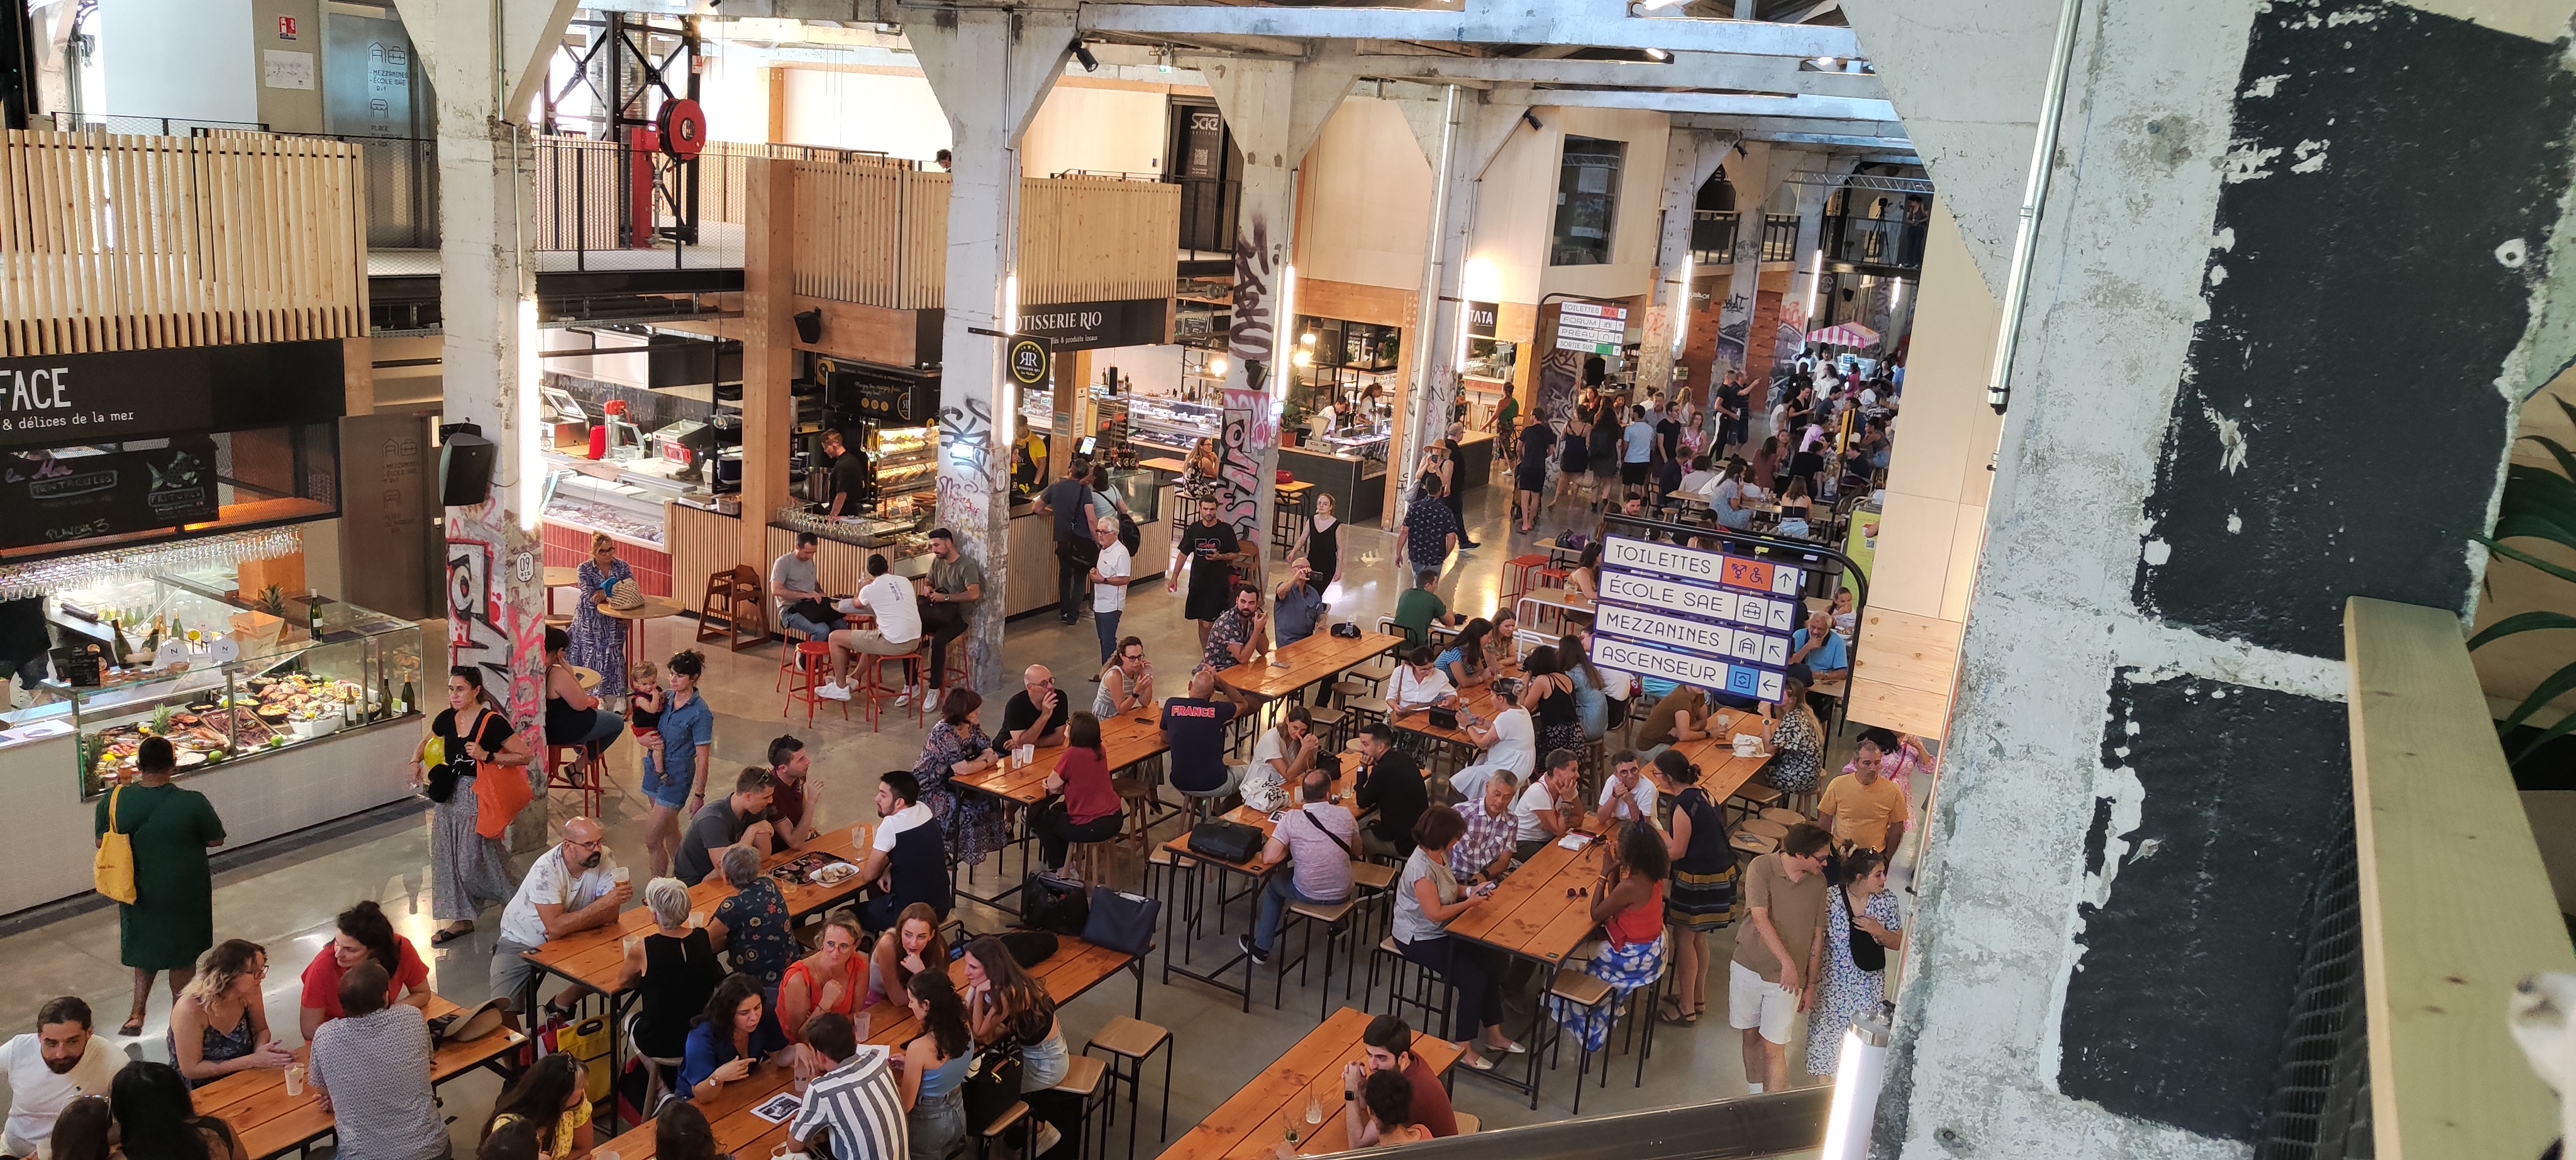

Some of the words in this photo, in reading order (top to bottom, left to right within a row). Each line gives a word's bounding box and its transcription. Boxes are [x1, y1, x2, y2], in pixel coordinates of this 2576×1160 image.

[373, 69, 409, 79] MEZZANINES
[373, 76, 392, 85] ÉCOLE
[1564, 304, 1599, 314] TOILETTES
[1080, 311, 1102, 330] RIO
[1469, 310, 1493, 325] TATA
[1563, 316, 1597, 326] FORUM
[1065, 335, 1084, 345] produits
[1562, 328, 1595, 338] PRÉAU
[1560, 340, 1580, 349] SORTIE
[3, 418, 13, 431] &
[19, 415, 67, 430] délices
[72, 412, 87, 425] de
[92, 411, 105, 423] la
[110, 411, 134, 421] mer
[520, 557, 530, 572] 09
[1616, 544, 1711, 574] TOILETTES
[1609, 575, 1674, 603] ÉCOLE
[1684, 592, 1723, 612] SAE
[1606, 612, 1719, 647] MEZZANINES
[1602, 646, 1716, 681] ASCENSEUR
[1171, 705, 1215, 718] FRANCE
